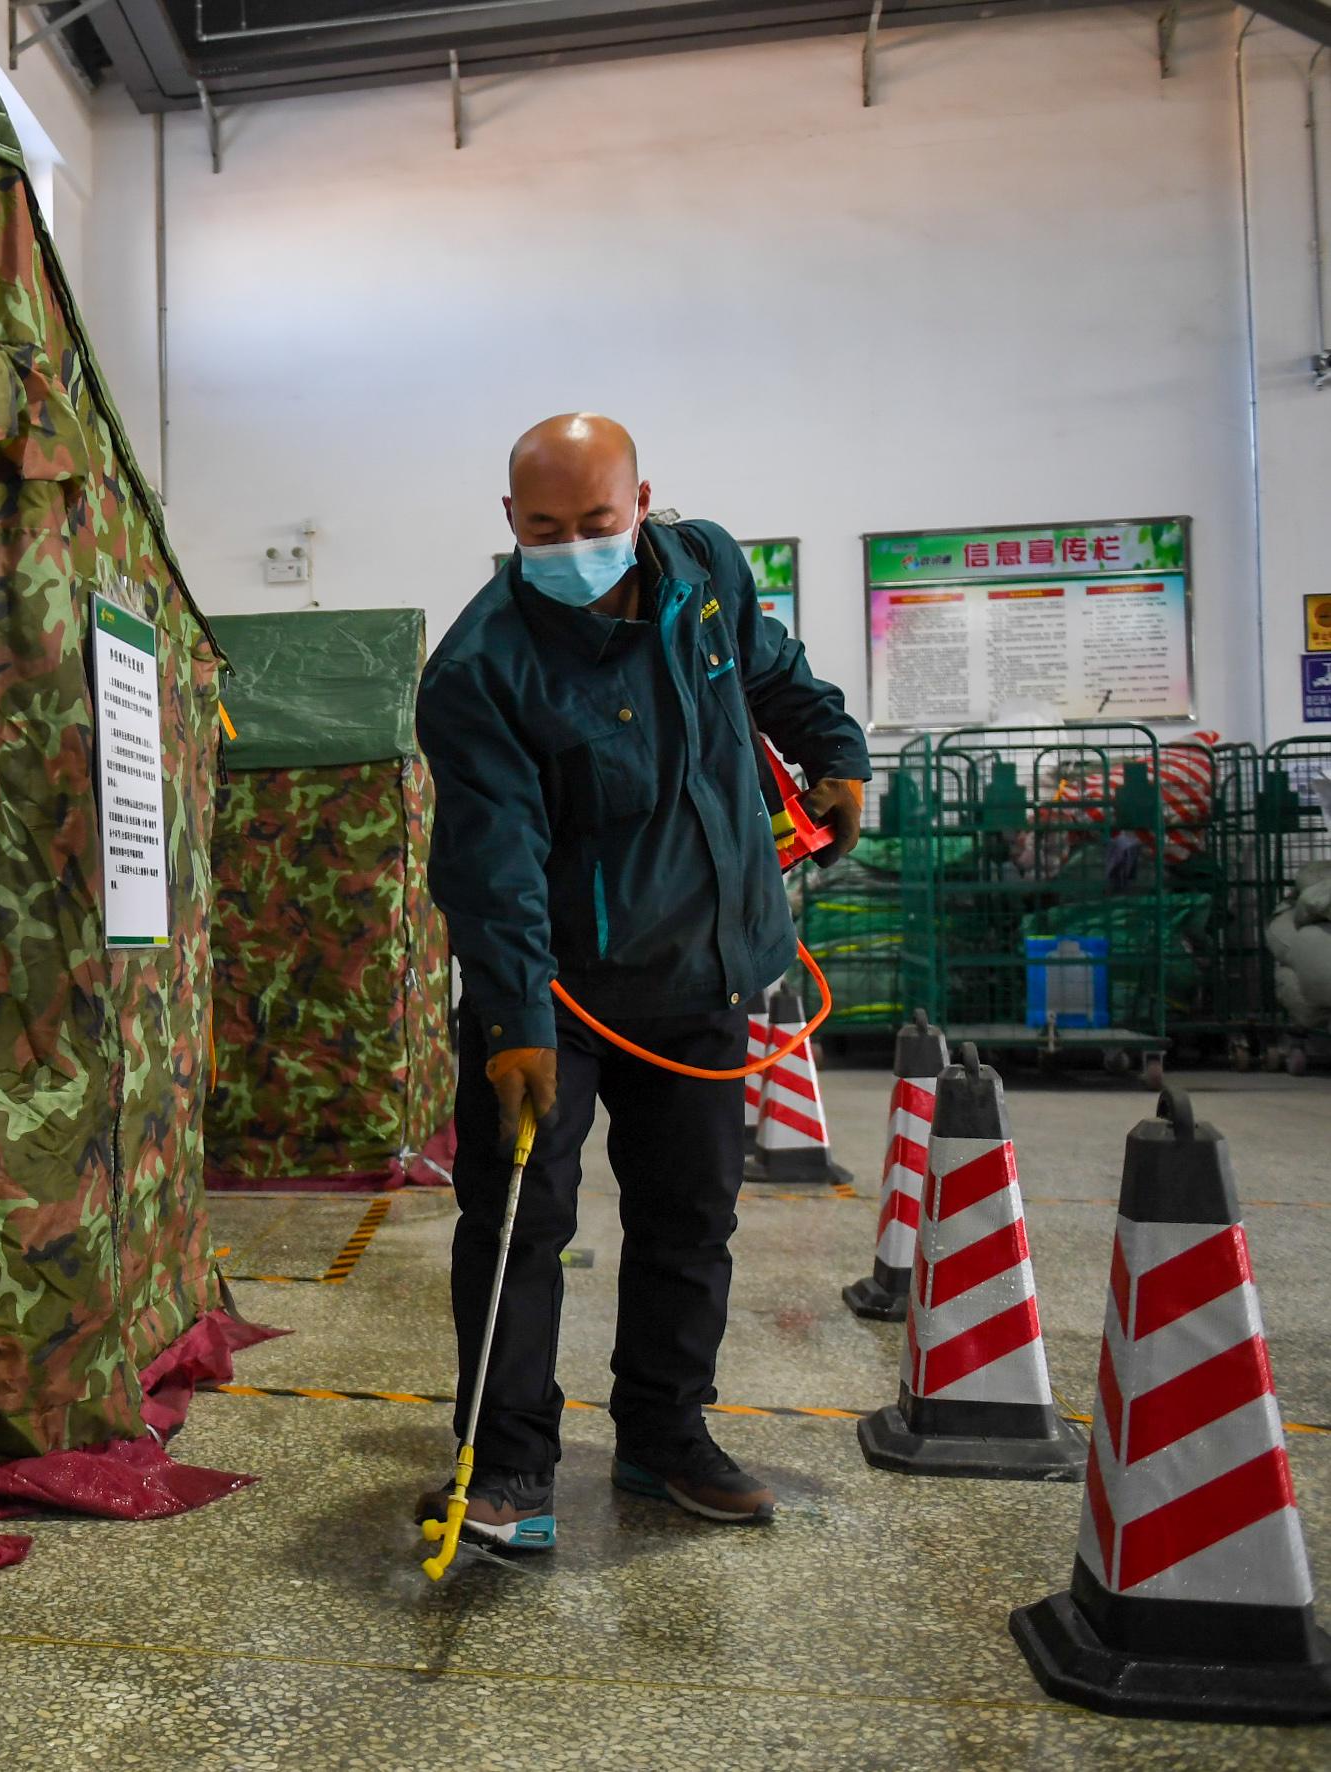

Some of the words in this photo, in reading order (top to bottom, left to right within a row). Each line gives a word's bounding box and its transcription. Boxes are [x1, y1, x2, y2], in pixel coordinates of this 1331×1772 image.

[963, 535, 1121, 568] 信息宣传栏
